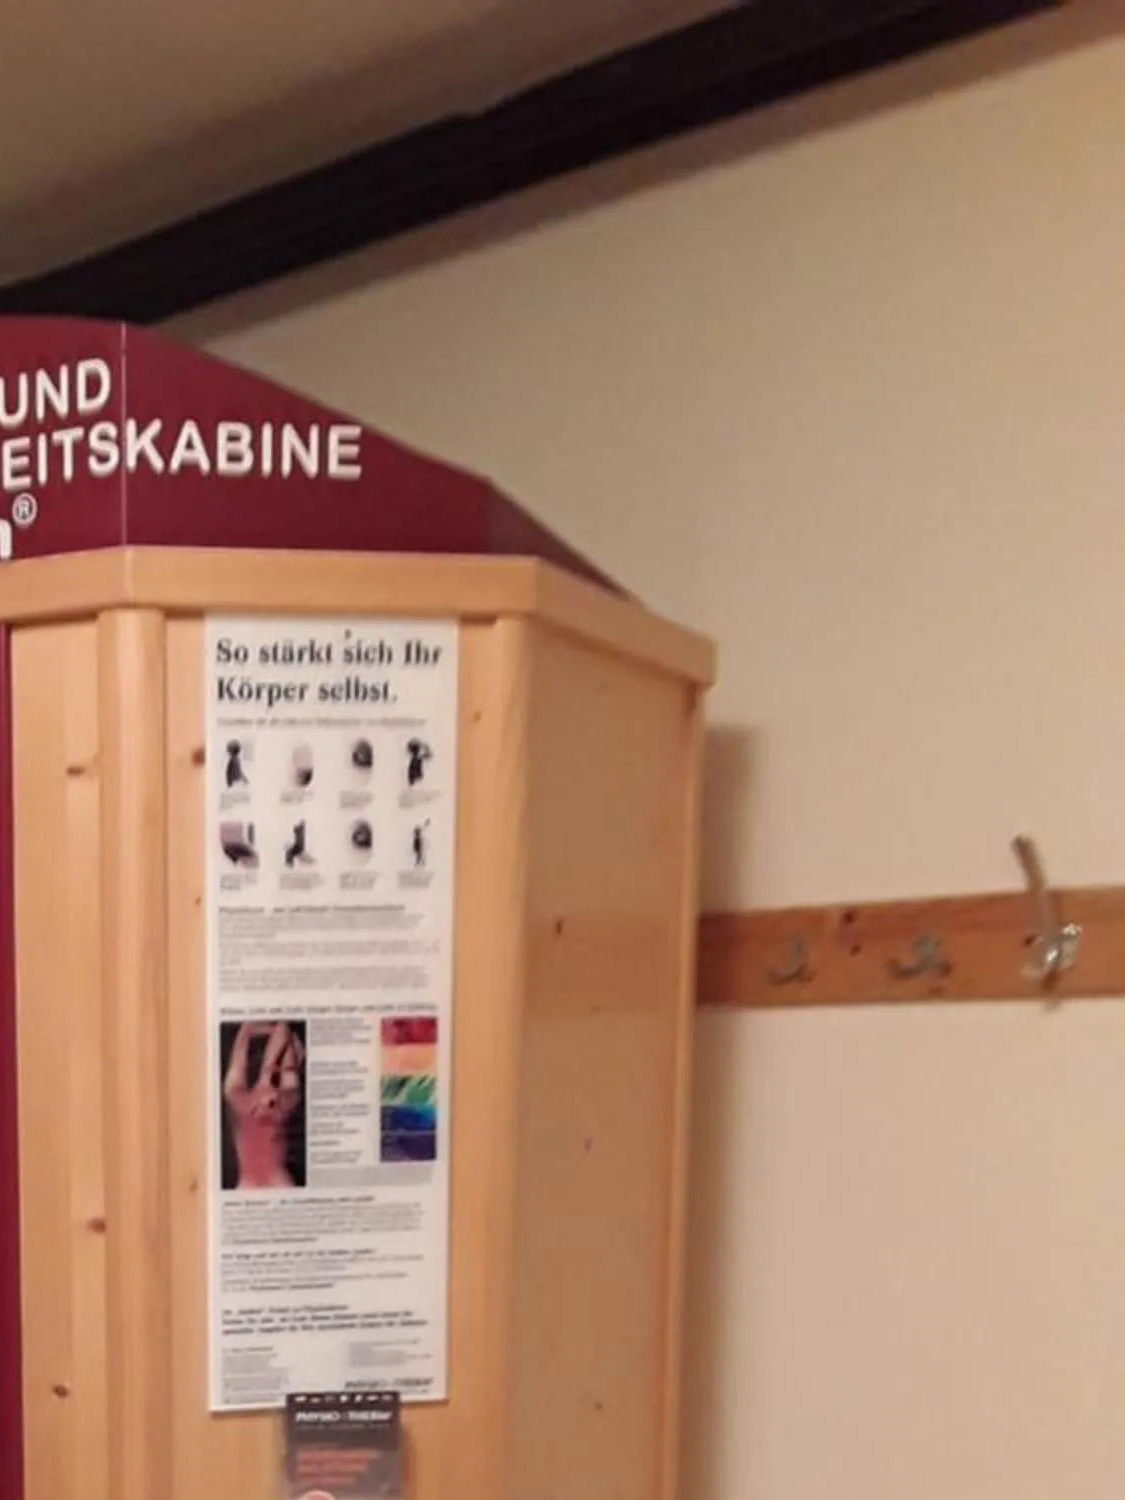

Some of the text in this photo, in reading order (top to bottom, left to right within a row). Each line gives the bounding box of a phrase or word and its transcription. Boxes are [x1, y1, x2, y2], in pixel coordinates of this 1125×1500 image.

[216, 637, 443, 664] So stärkt sich Ihr
[216, 675, 398, 708] Körper selbst.
